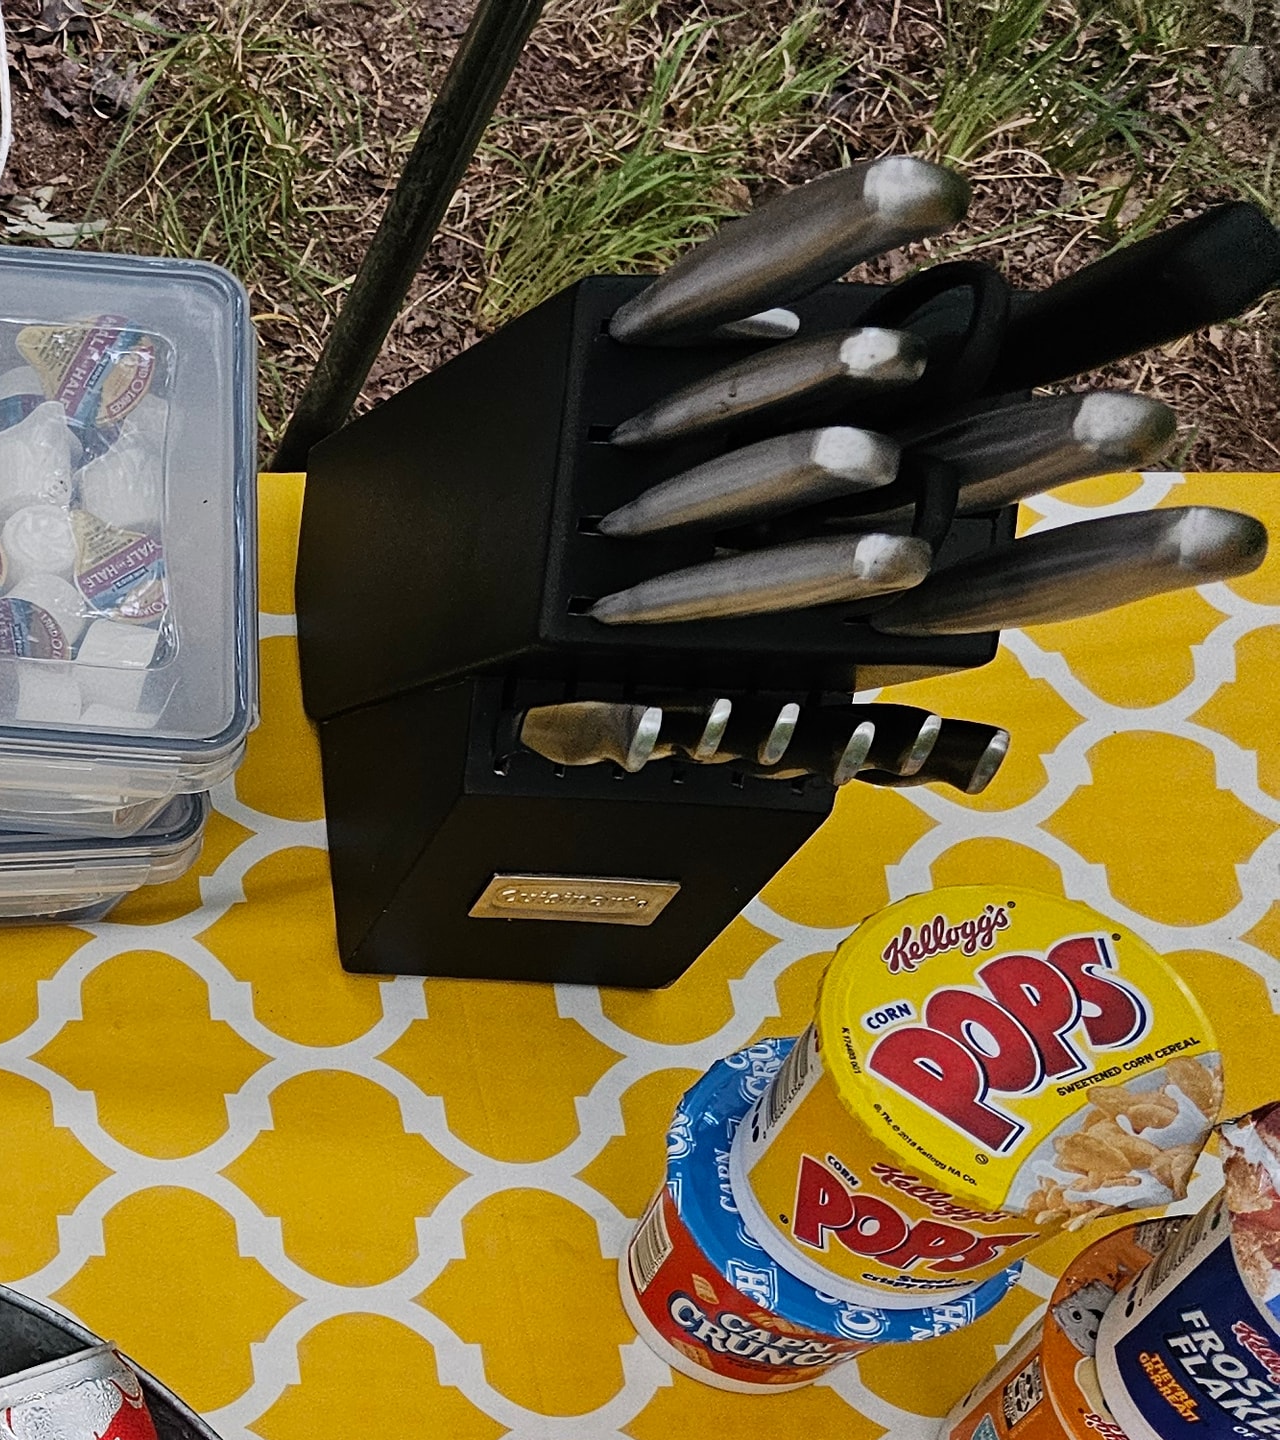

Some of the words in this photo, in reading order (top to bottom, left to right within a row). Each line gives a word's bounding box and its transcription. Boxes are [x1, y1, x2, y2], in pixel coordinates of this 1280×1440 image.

[883, 903, 1009, 974] Kellogg's
[866, 1003, 912, 1030] CORN
[869, 937, 1148, 1153] POPS
[1056, 1065, 1123, 1098] SWEETENED
[1122, 1053, 1155, 1077] CORN
[1156, 1036, 1201, 1061] CEREAL
[827, 1155, 859, 1187] CORN
[870, 1162, 1012, 1222] Kellogg's
[916, 1146, 948, 1170] Kellogg
[948, 1165, 961, 1178] NA
[962, 1174, 978, 1186] Co.
[793, 1155, 1035, 1274] POPS
[719, 1312, 835, 1353] CAP'N
[1150, 1353, 1198, 1408] THEY'RE
[1233, 1426, 1259, 1438] OF
